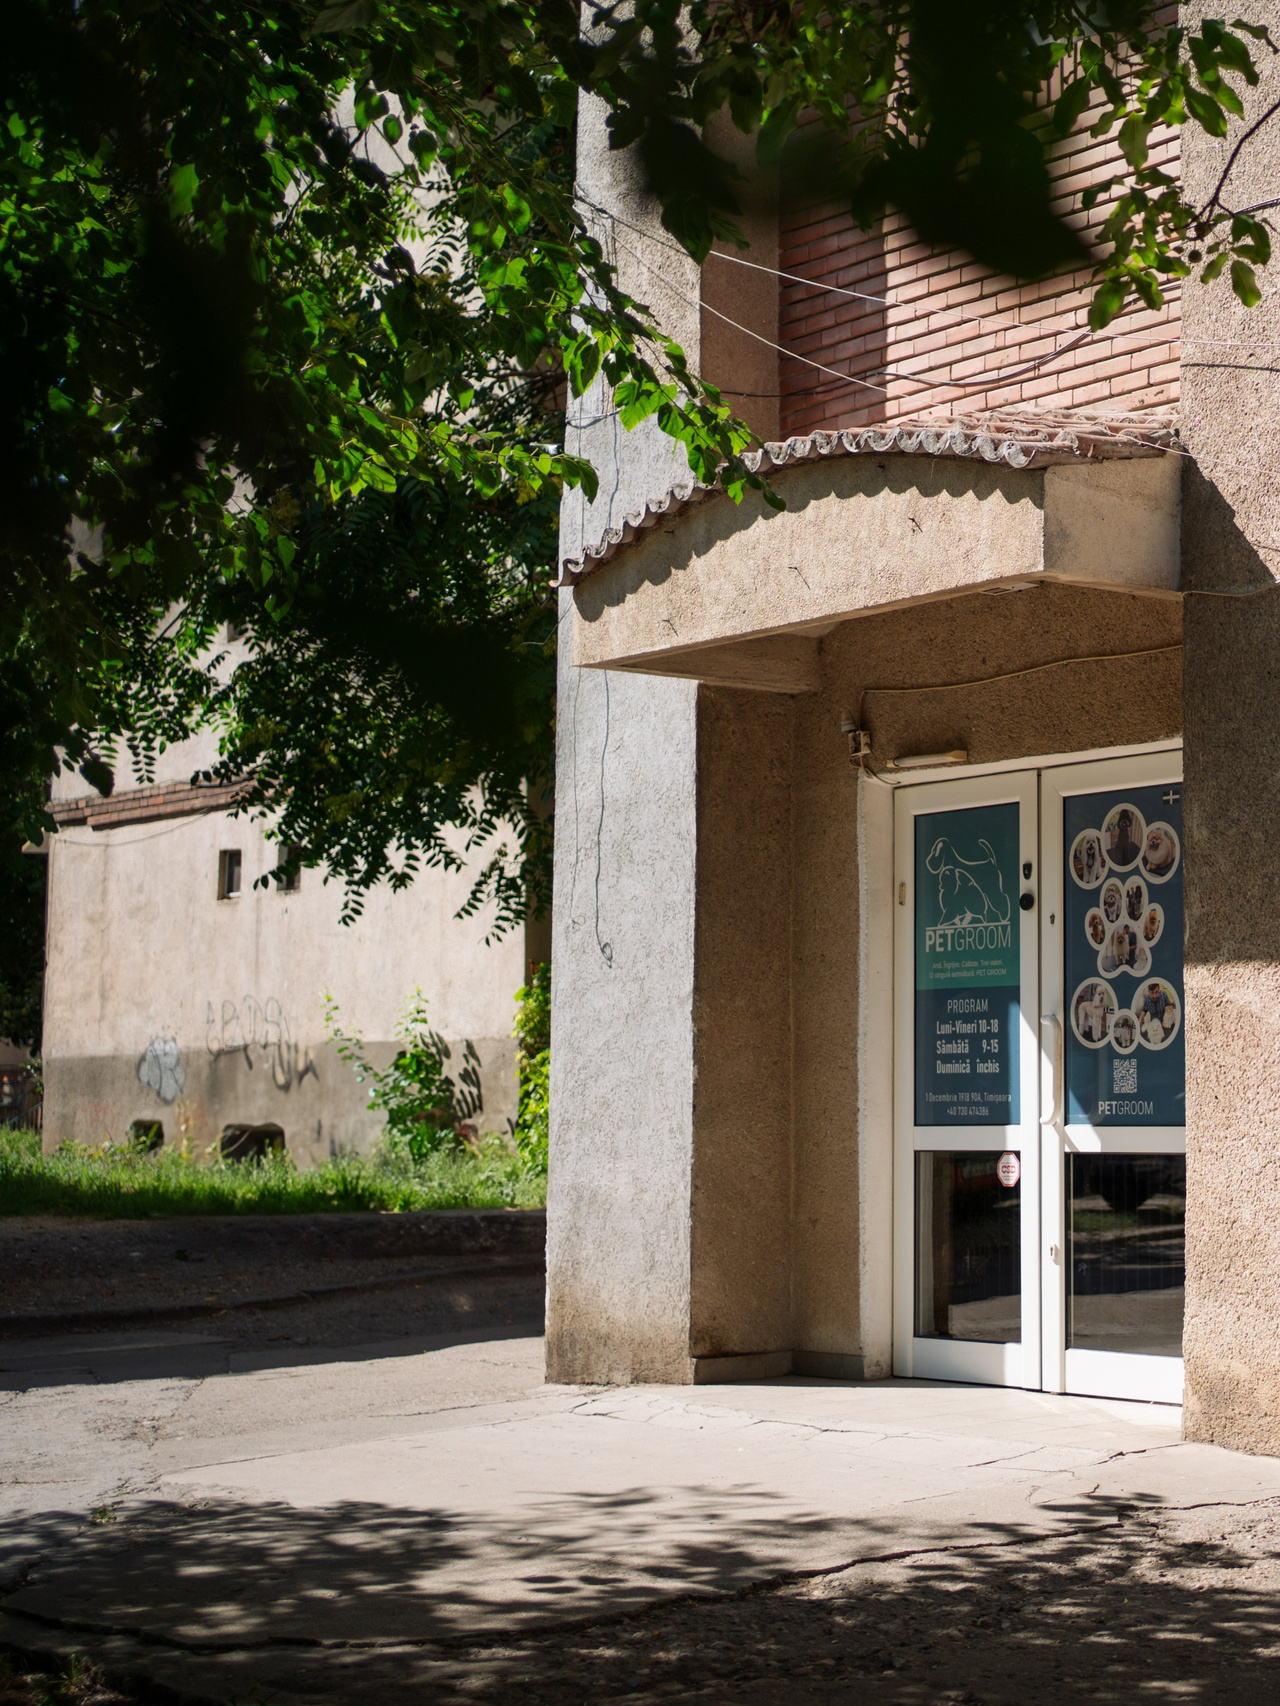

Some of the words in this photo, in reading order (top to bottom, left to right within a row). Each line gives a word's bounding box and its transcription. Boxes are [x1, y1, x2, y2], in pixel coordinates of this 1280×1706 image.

[926, 925, 1011, 953] PETGROOM
[947, 999, 989, 1014] PROGRAM
[936, 1020, 977, 1035] Luni-Vineri
[979, 1019, 999, 1034] 10-18
[936, 1039, 969, 1054] Sâmbătă
[982, 1039, 999, 1053] 9-15
[936, 1059, 970, 1074] Duminică
[976, 1058, 1000, 1073] închis
[929, 1091, 957, 1102] Decembrie
[1098, 1101, 1154, 1115] PETGROOM
